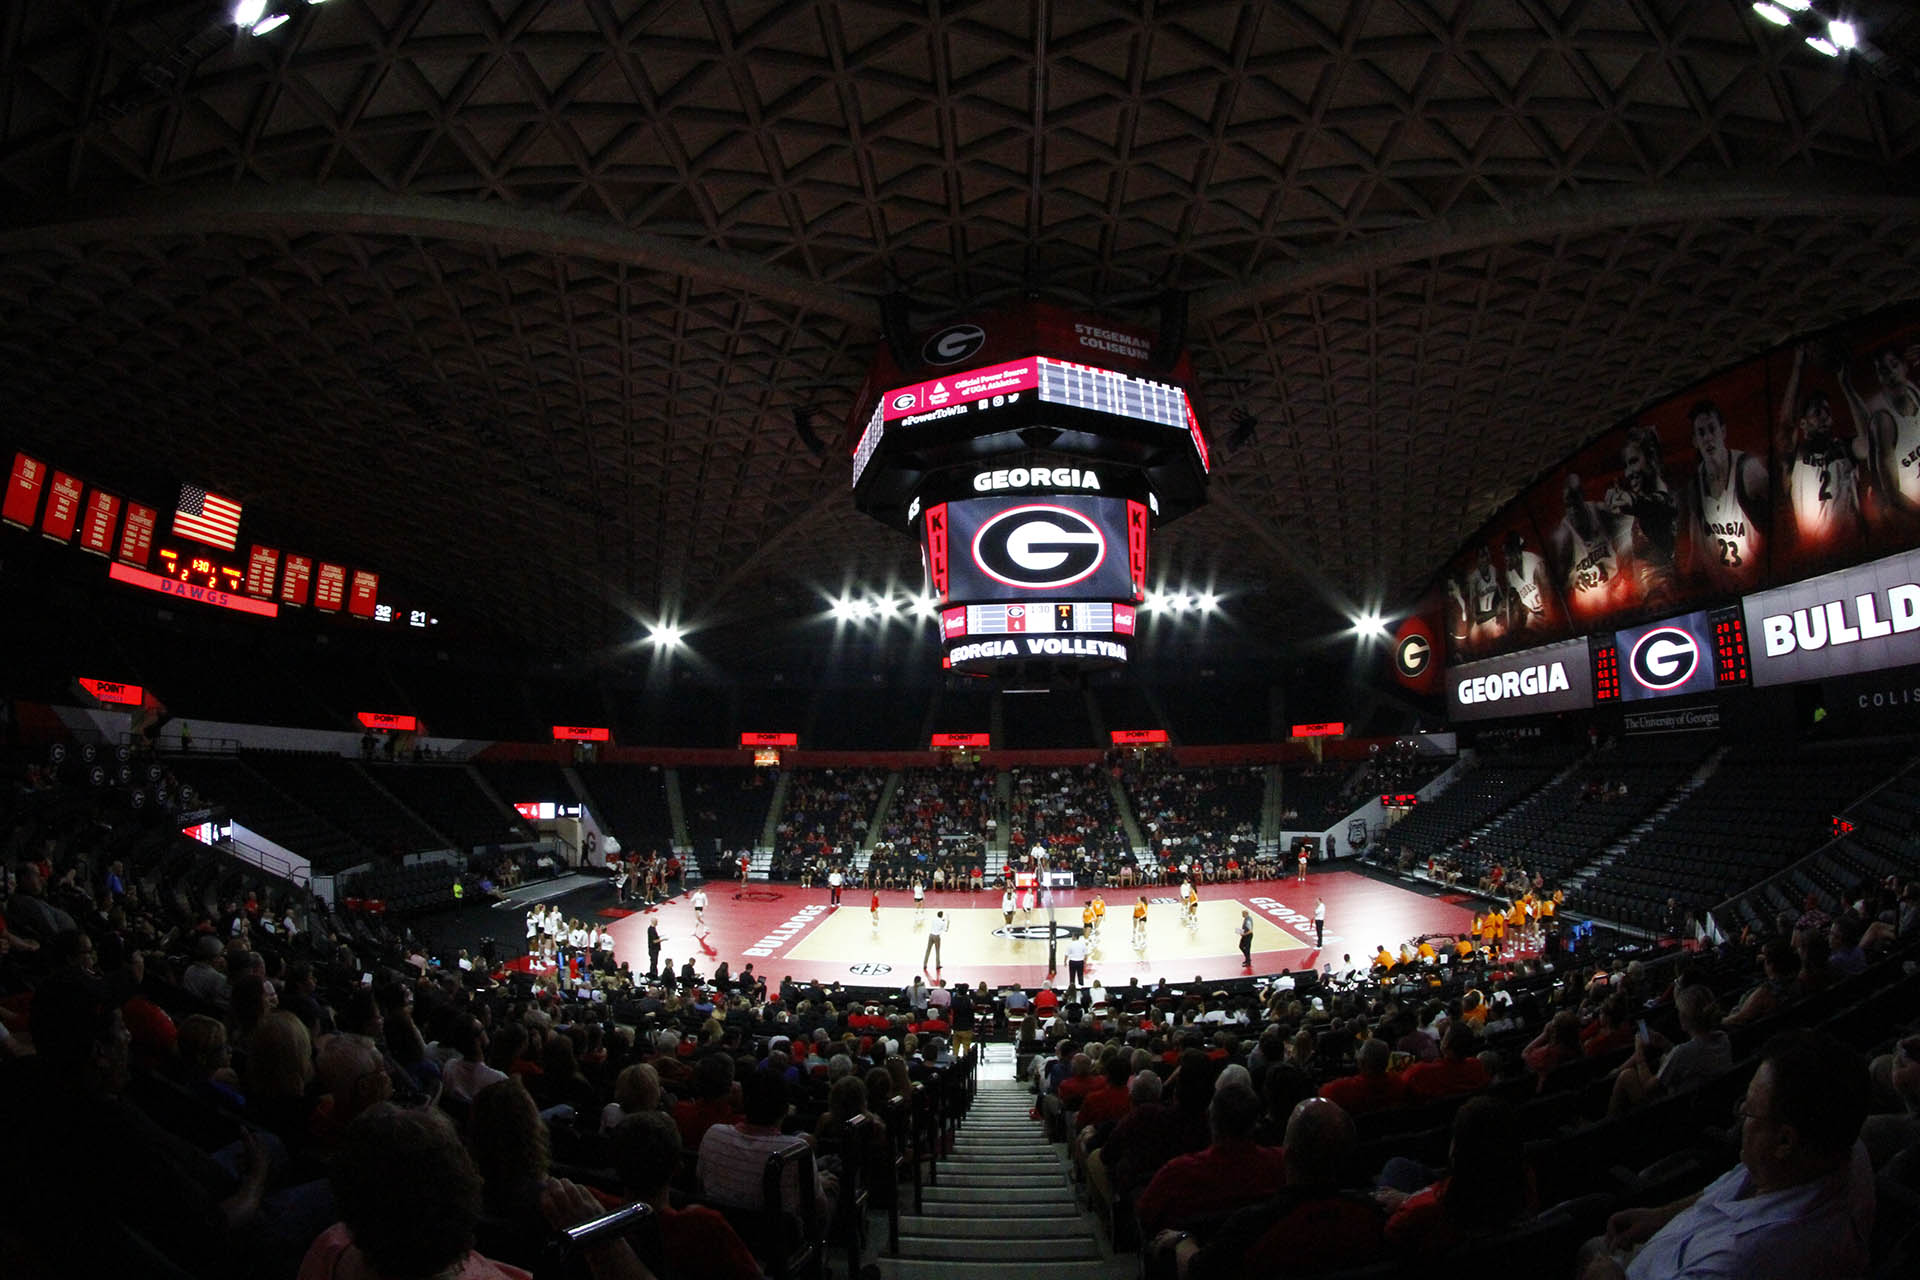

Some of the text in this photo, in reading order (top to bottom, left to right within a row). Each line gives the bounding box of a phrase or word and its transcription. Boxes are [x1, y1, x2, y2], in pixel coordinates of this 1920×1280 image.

[1074, 324, 1151, 350] STEGEMAN
[1080, 336, 1149, 360] COLISEUM
[955, 367, 1029, 390] Official Power Source
[970, 383, 988, 394] UGA
[973, 467, 1101, 492] GEORGIA
[1817, 470, 1833, 501] 2
[1718, 538, 1742, 568] 23
[168, 562, 175, 574] 4
[181, 569, 189, 581] 2
[192, 559, 209, 573] 1:30
[208, 577, 216, 588] 2
[160, 579, 230, 606] DAWGS
[375, 604, 392, 617] 32
[410, 610, 426, 622] 21
[1058, 605, 1070, 617] T
[1762, 582, 1920, 658] BULLD
[949, 638, 1128, 665] GEORGIA VOLLEYBALL
[97, 681, 125, 694] POINT
[1458, 661, 1570, 705] GEORGIA
[1858, 687, 1920, 708] COLIS
[374, 714, 399, 723] POINT
[1625, 711, 1720, 729] The University of Georgia
[568, 727, 592, 735] POINT
[742, 904, 828, 957] BULLDOGS
